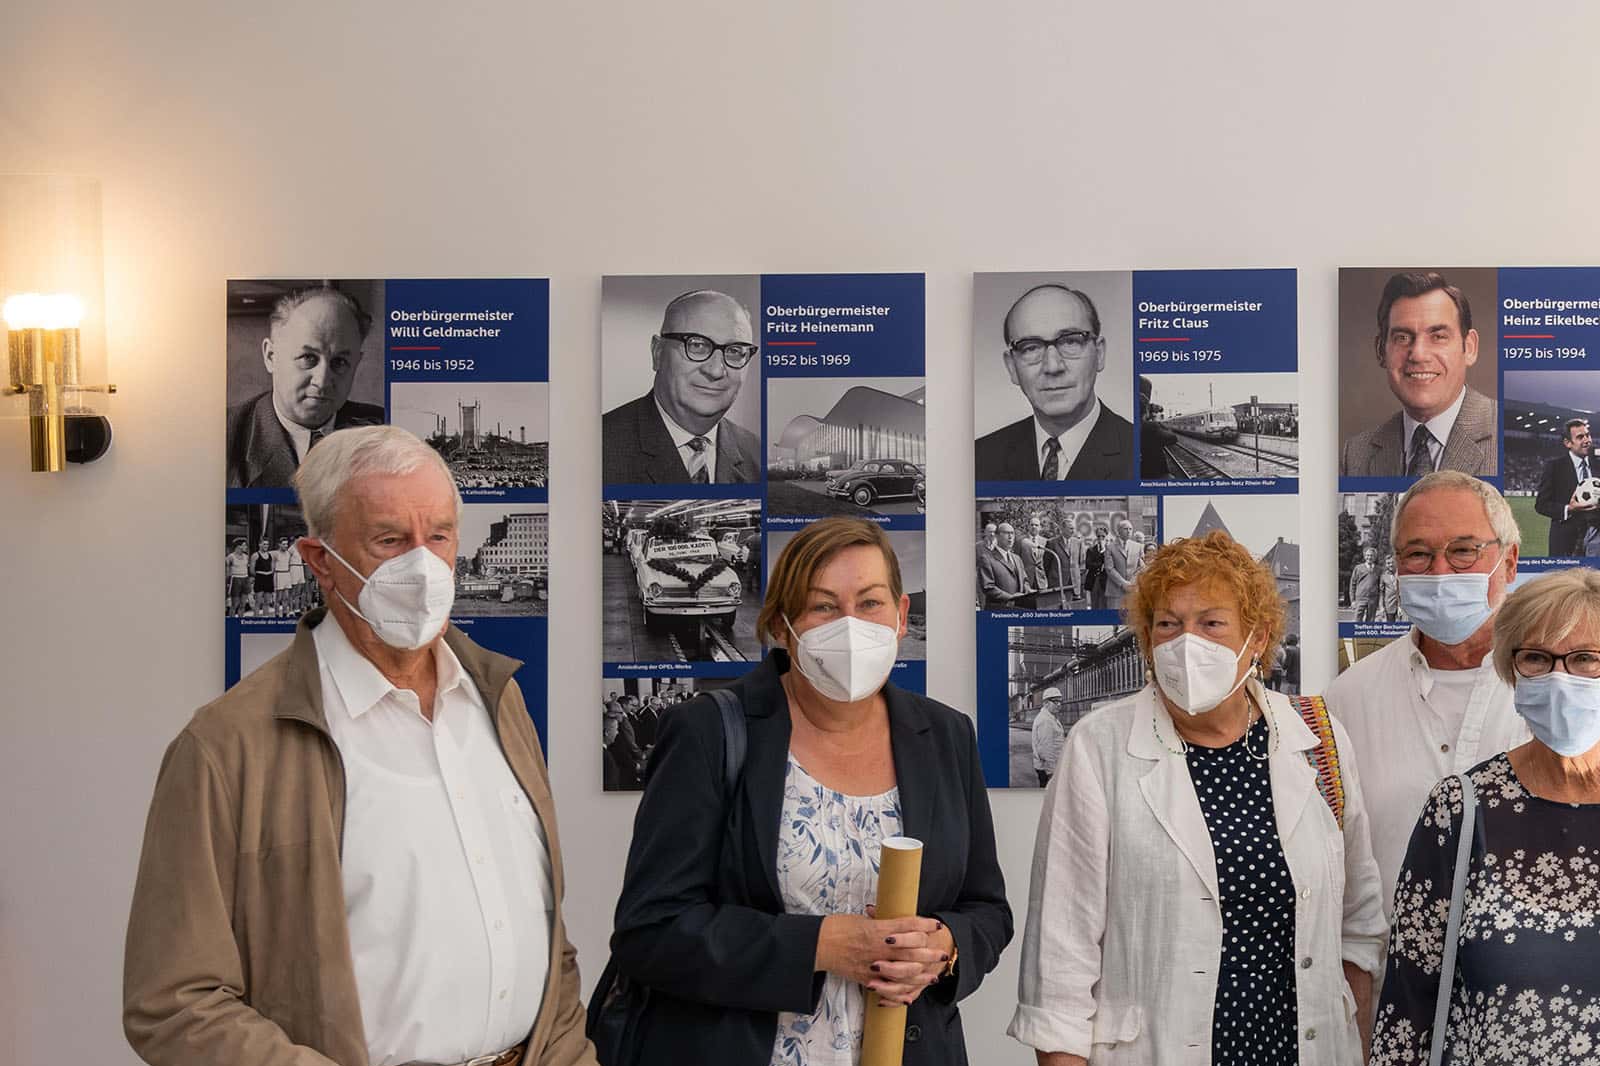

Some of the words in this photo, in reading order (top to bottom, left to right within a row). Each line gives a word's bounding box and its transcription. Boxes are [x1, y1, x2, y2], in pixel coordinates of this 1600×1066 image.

[766, 305, 891, 318] Oberbürgermeister
[1138, 301, 1263, 313] Oberbürgermeister
[390, 310, 515, 323] Oberbürgermeister
[1503, 314, 1542, 326] Heinz
[767, 321, 798, 333] Fritz
[800, 321, 874, 333] Heinemann
[1139, 317, 1170, 329] Fritz
[1172, 317, 1209, 329] Claus
[390, 326, 420, 338] Willi
[422, 326, 501, 338] Geldmacher
[1138, 350, 1169, 362] 1969
[1171, 350, 1191, 362] bis
[1192, 350, 1222, 362] 1975
[1503, 347, 1533, 359] 1975
[1535, 347, 1554, 359] bis
[1555, 347, 1587, 359] 1994
[390, 359, 421, 371] 1946
[423, 359, 442, 371] bis
[443, 359, 475, 371] 1952
[766, 354, 797, 366] 1952
[799, 354, 818, 366] bis
[820, 354, 851, 366] 1969
